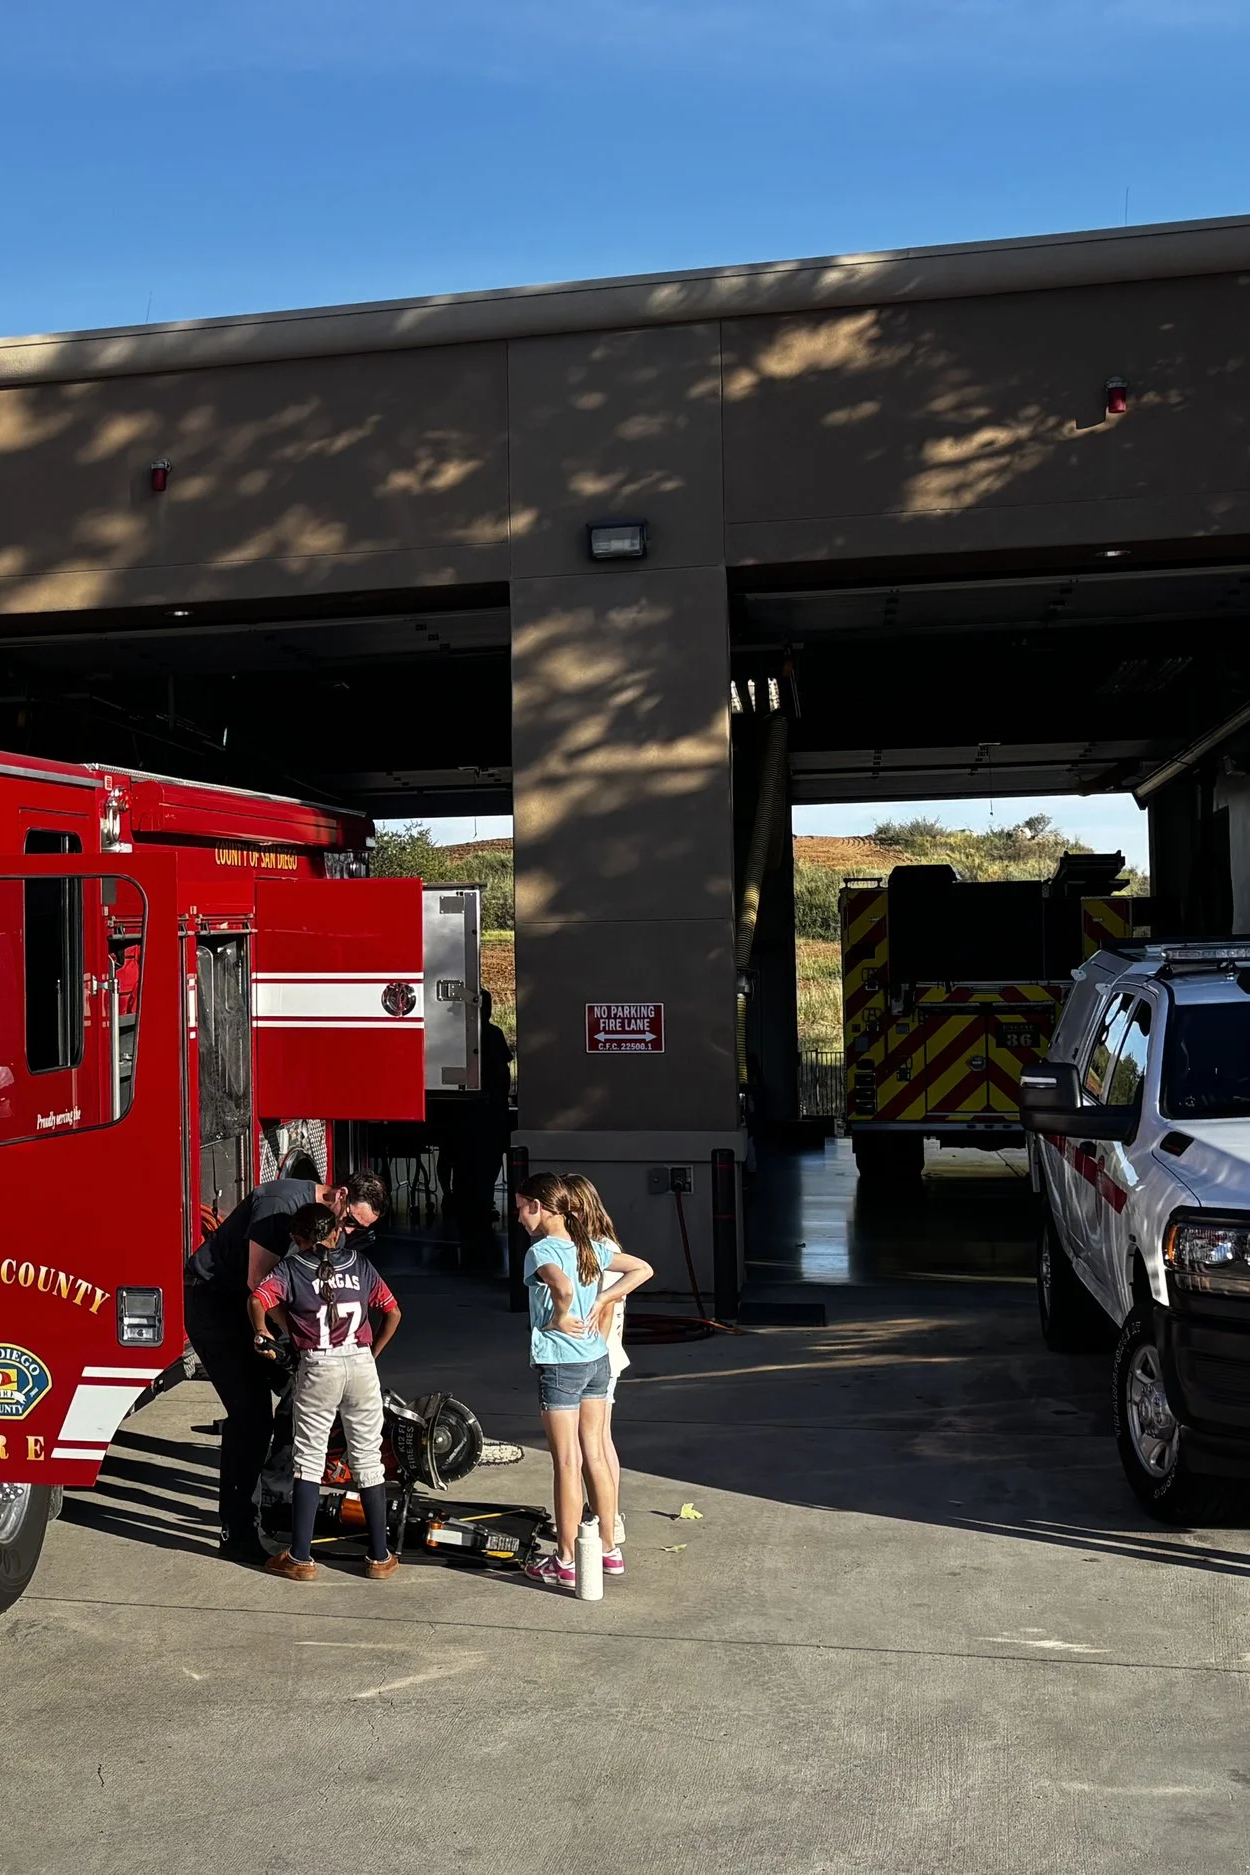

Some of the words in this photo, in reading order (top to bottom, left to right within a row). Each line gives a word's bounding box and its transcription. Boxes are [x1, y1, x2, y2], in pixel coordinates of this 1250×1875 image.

[261, 848, 276, 869] SAN
[277, 849, 298, 871] DIEGO
[594, 1006, 608, 1018] NO
[611, 1005, 655, 1018] PARKING
[600, 1018, 622, 1031] FIRE
[624, 1018, 650, 1031] LANE
[598, 1042, 620, 1051] C.F.C.
[620, 1042, 653, 1051] 22500.1
[1006, 1033, 1032, 1047] 36
[0, 1258, 111, 1315] COUNTY
[311, 1273, 361, 1295] VRGAS
[316, 1301, 362, 1349] 17
